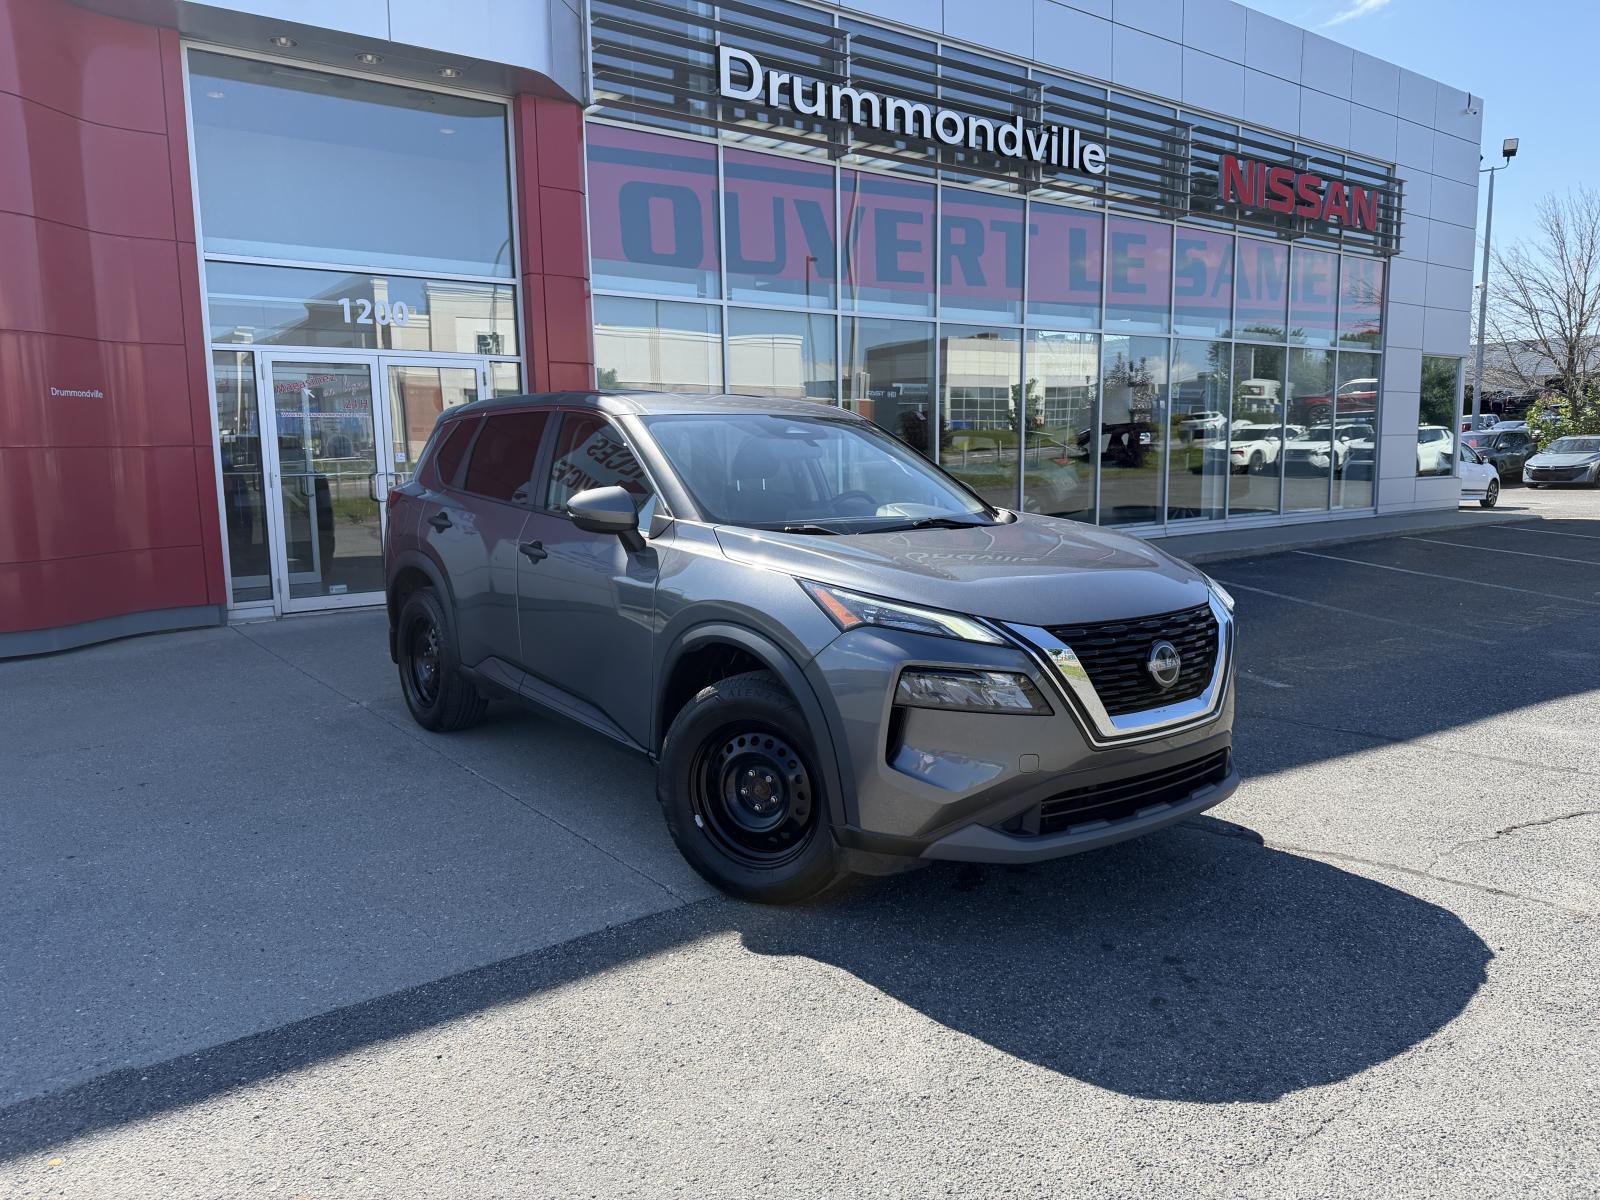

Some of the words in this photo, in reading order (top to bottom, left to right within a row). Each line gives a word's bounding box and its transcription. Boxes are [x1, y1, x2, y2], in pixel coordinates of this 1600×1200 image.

[717, 45, 1106, 174] Drummondville
[1219, 154, 1378, 231] NISSAN
[618, 180, 1038, 289] OUVERT
[1069, 228, 1146, 294] LE
[337, 297, 409, 327] 1200
[50, 386, 104, 399] Drummondville
[1149, 658, 1180, 670] NISSAN
